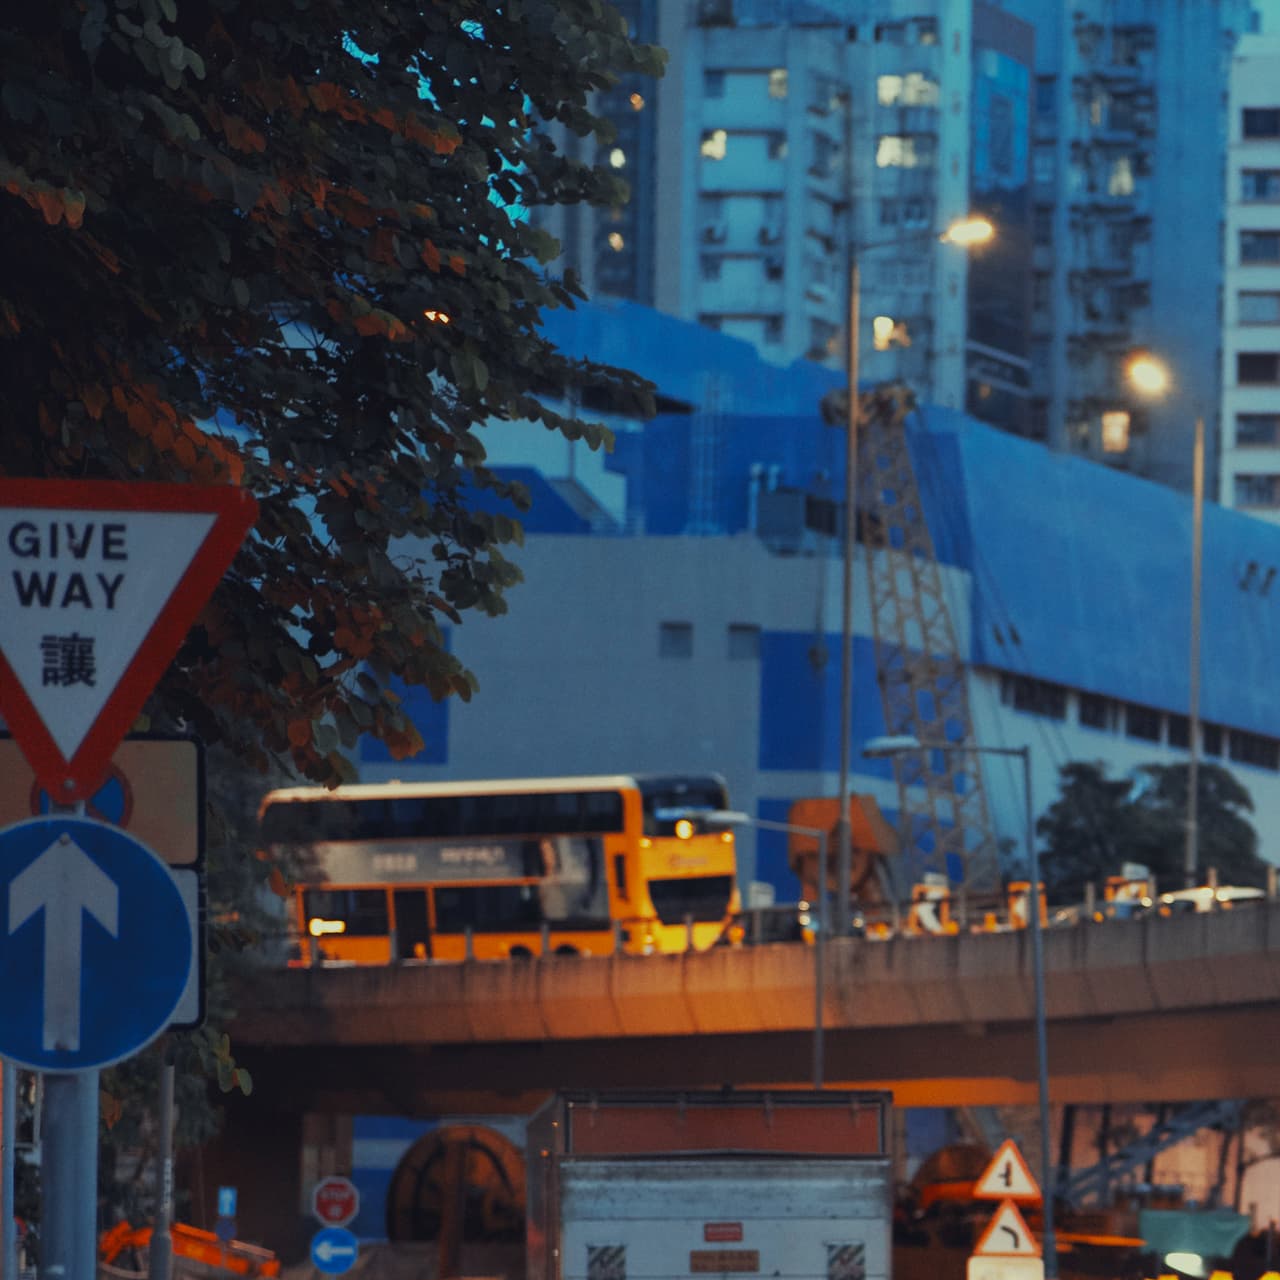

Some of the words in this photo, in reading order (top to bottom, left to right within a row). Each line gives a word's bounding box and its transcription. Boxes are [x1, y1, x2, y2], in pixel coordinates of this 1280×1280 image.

[8, 521, 128, 561] GIVE
[12, 571, 124, 610] WAY
[40, 632, 96, 688] 讓
